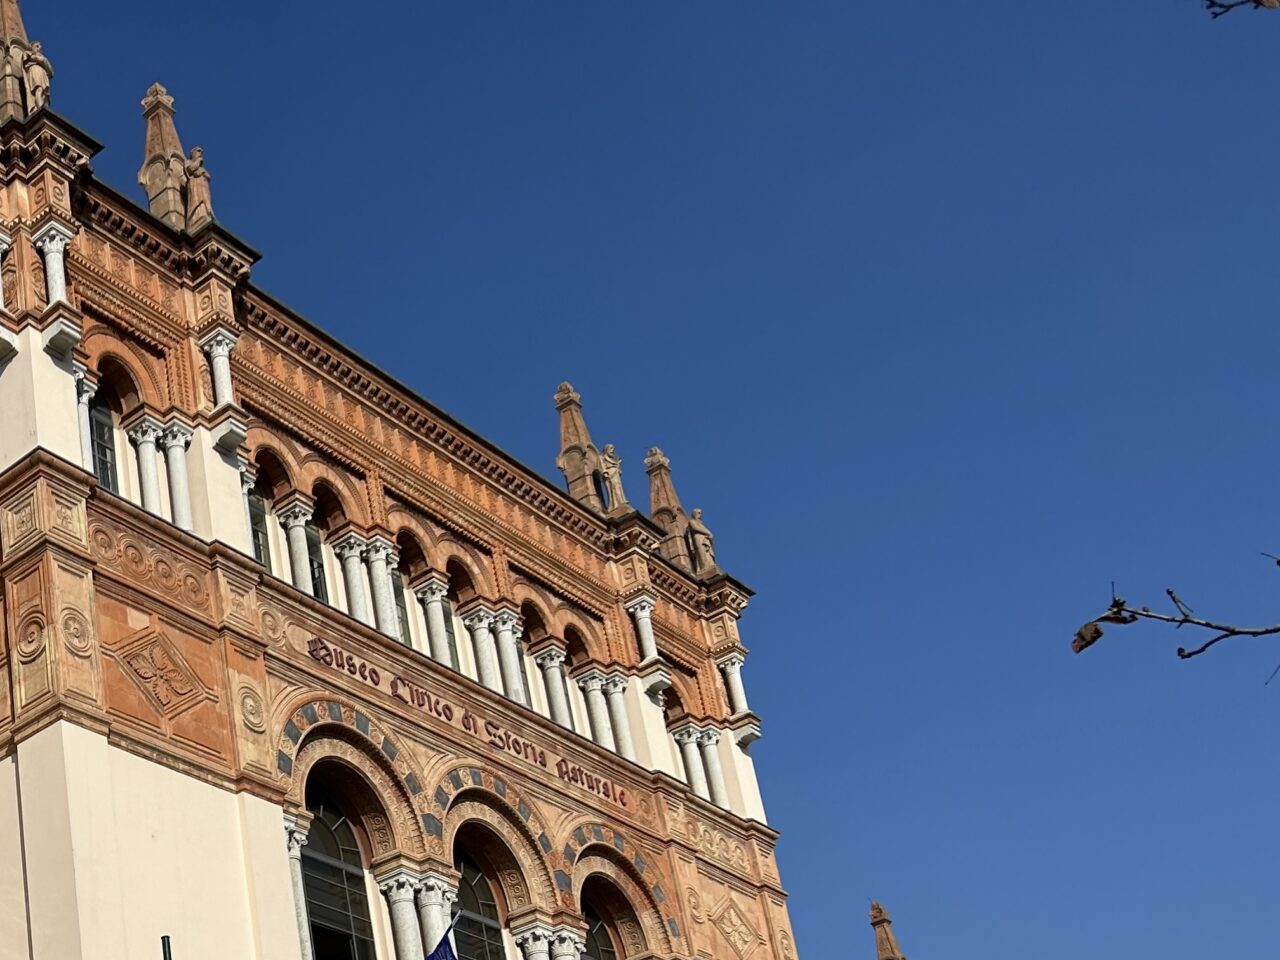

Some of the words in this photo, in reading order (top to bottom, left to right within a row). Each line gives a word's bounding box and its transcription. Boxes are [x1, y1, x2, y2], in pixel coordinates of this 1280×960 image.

[307, 637, 380, 686] Museo
[390, 676, 454, 722] Civico
[462, 706, 478, 735] di
[485, 720, 548, 768] Storia
[556, 758, 627, 807] Naturale
